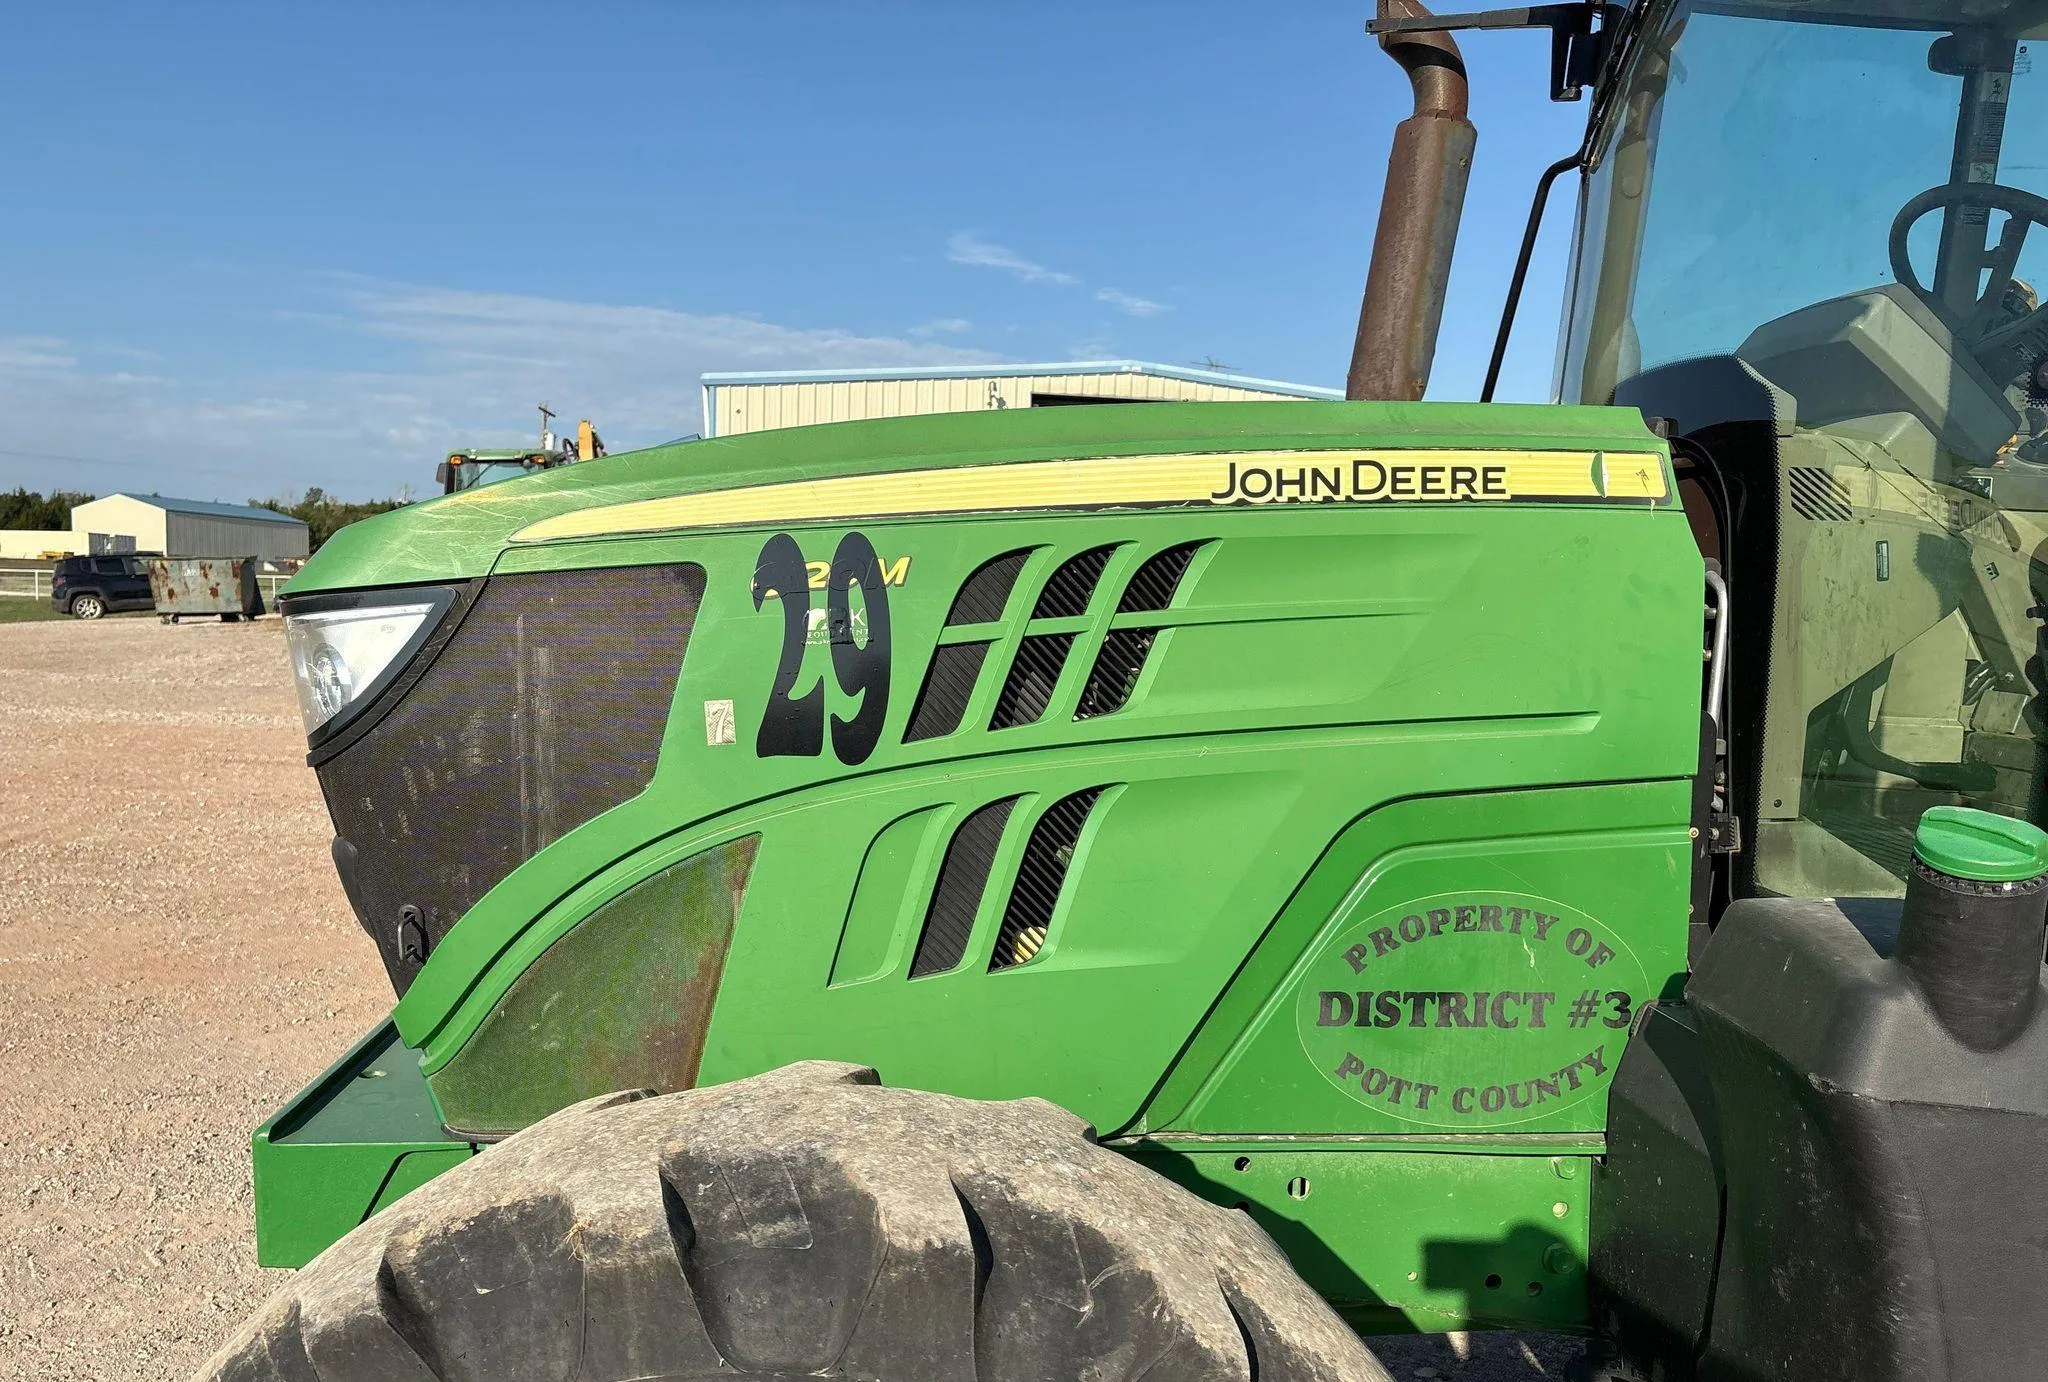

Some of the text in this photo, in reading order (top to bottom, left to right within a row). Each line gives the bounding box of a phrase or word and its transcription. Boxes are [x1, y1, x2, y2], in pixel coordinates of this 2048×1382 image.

[1211, 460, 1507, 499] JOHN DEERE
[753, 532, 892, 766] 29
[1341, 905, 1617, 975] PROPERTY OF
[1316, 989, 1632, 1029] DISTRICT #3
[1334, 1045, 1608, 1114] POTT COUNTY
